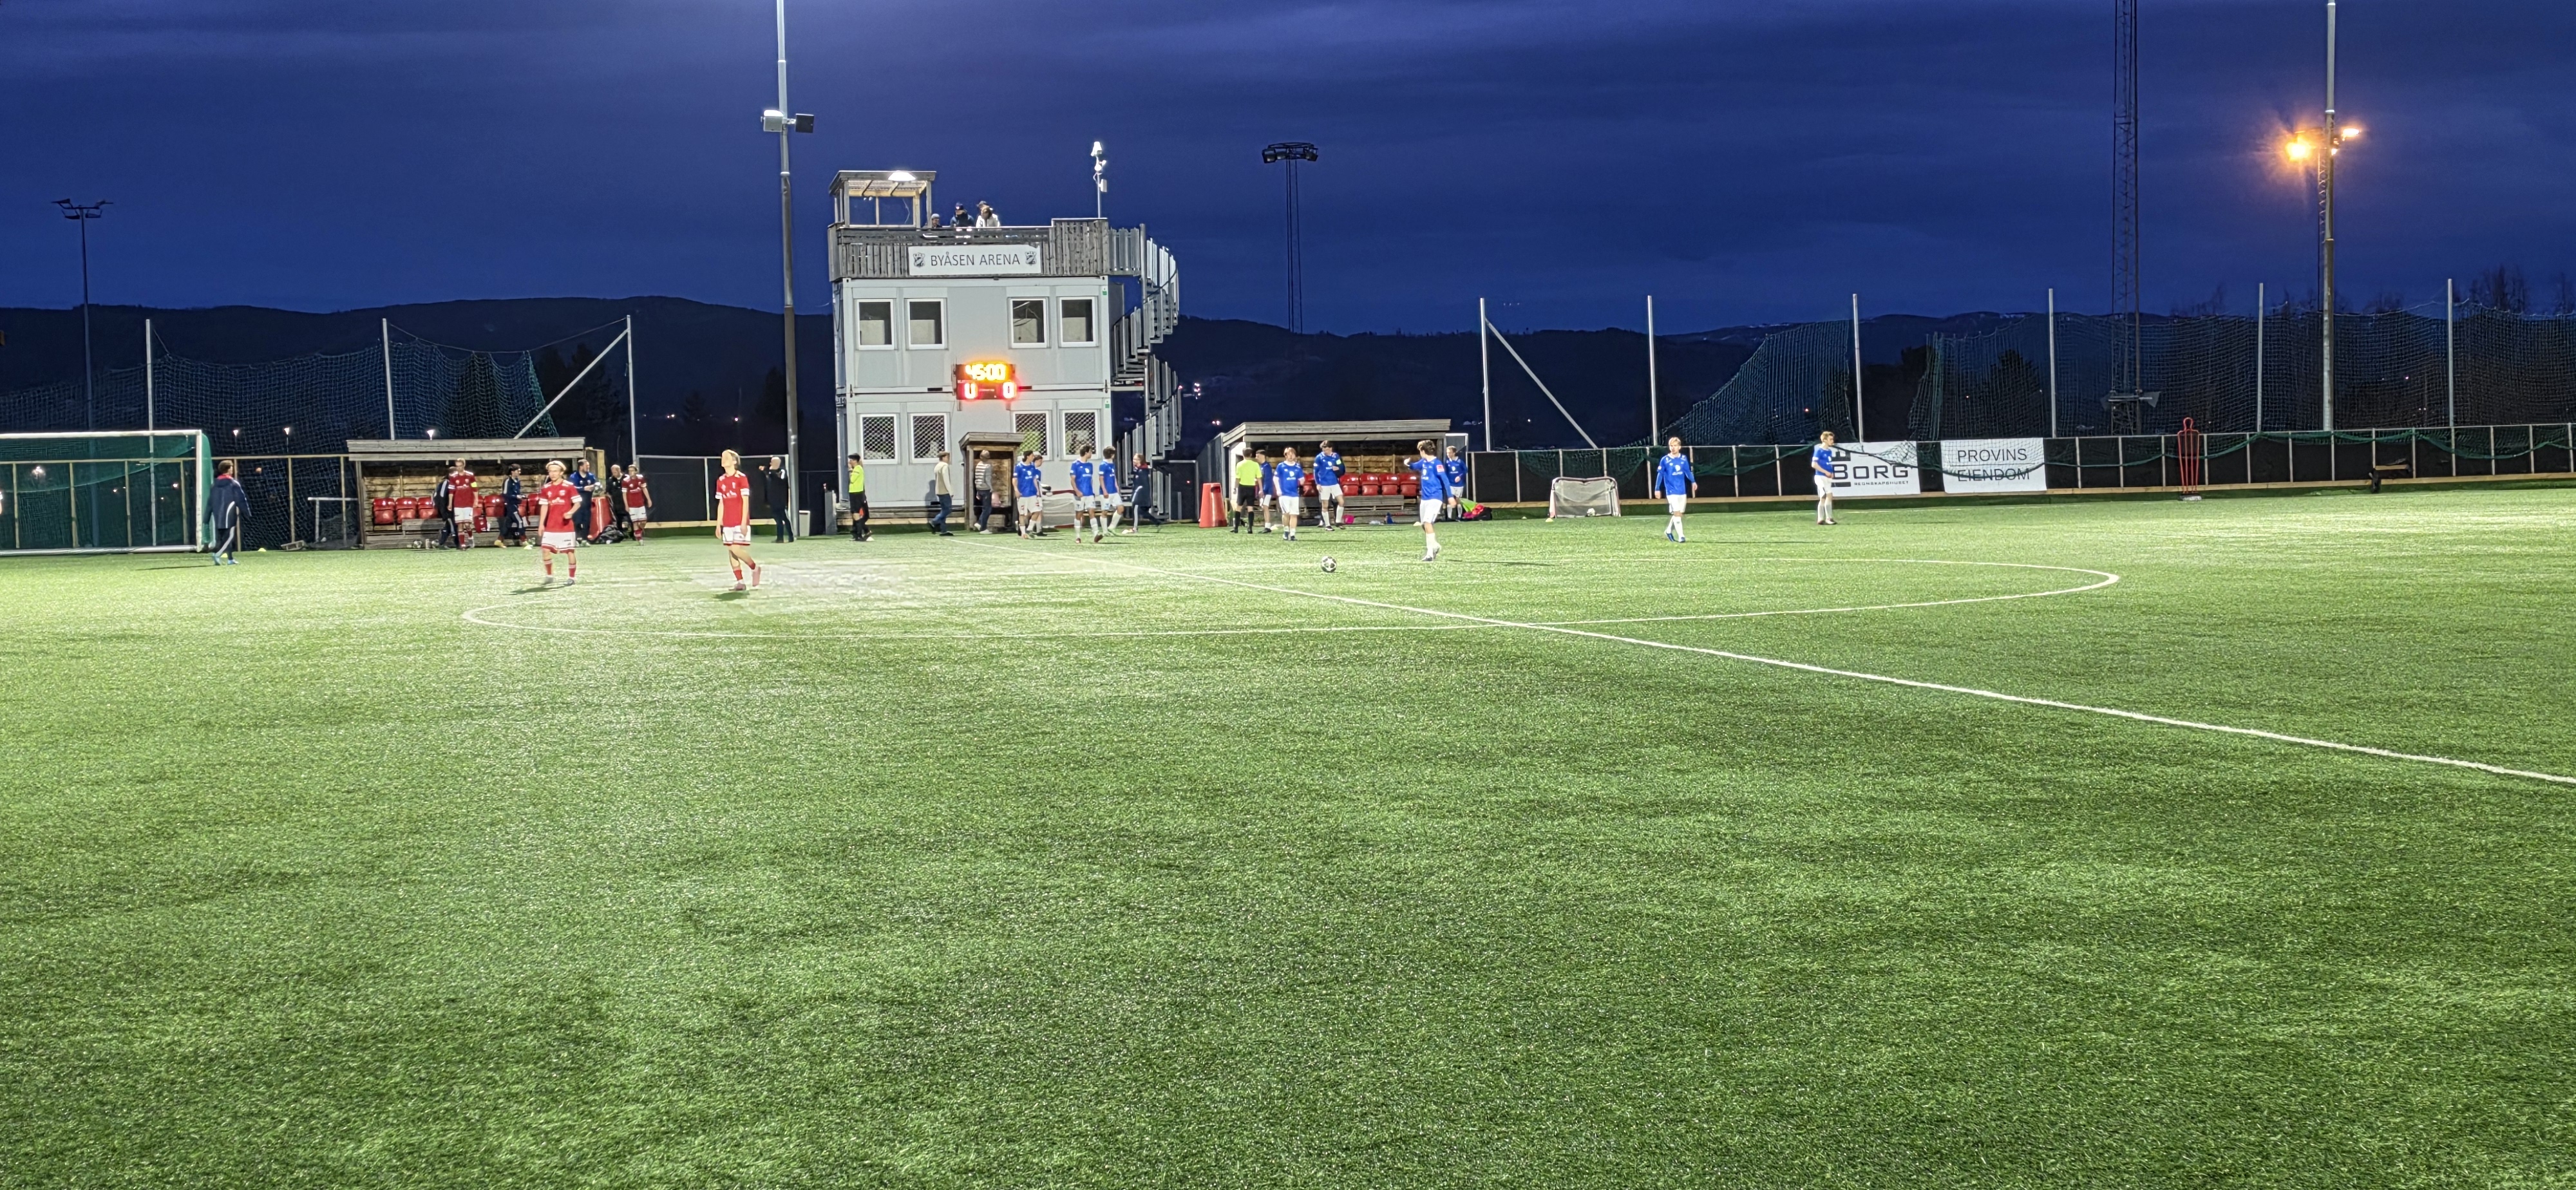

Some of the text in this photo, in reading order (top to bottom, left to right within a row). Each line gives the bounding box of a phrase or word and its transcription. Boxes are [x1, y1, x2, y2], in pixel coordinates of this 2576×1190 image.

[931, 252, 1020, 266] BYÅSEN ARENA
[1003, 382, 1015, 399] 0
[1958, 448, 2027, 462] PROVINS
[1832, 464, 1908, 480] BORG
[1958, 468, 2029, 482] EIENDOM
